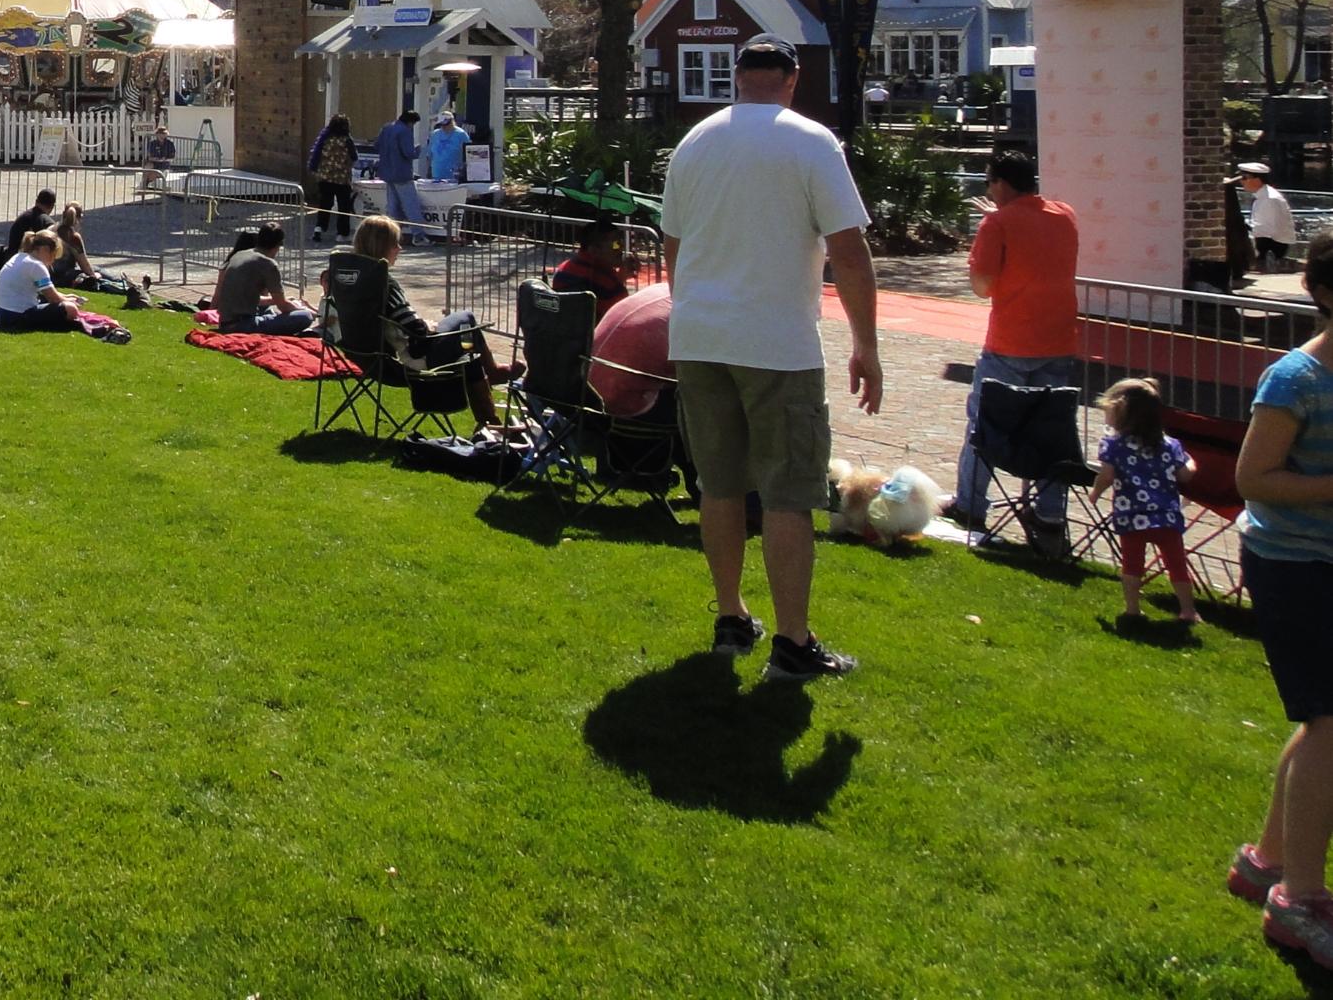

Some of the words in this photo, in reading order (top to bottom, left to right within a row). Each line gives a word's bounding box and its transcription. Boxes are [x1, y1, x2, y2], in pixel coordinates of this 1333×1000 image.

[677, 28, 692, 37] THE
[422, 212, 440, 223] OR
[443, 212, 463, 223] LFE
